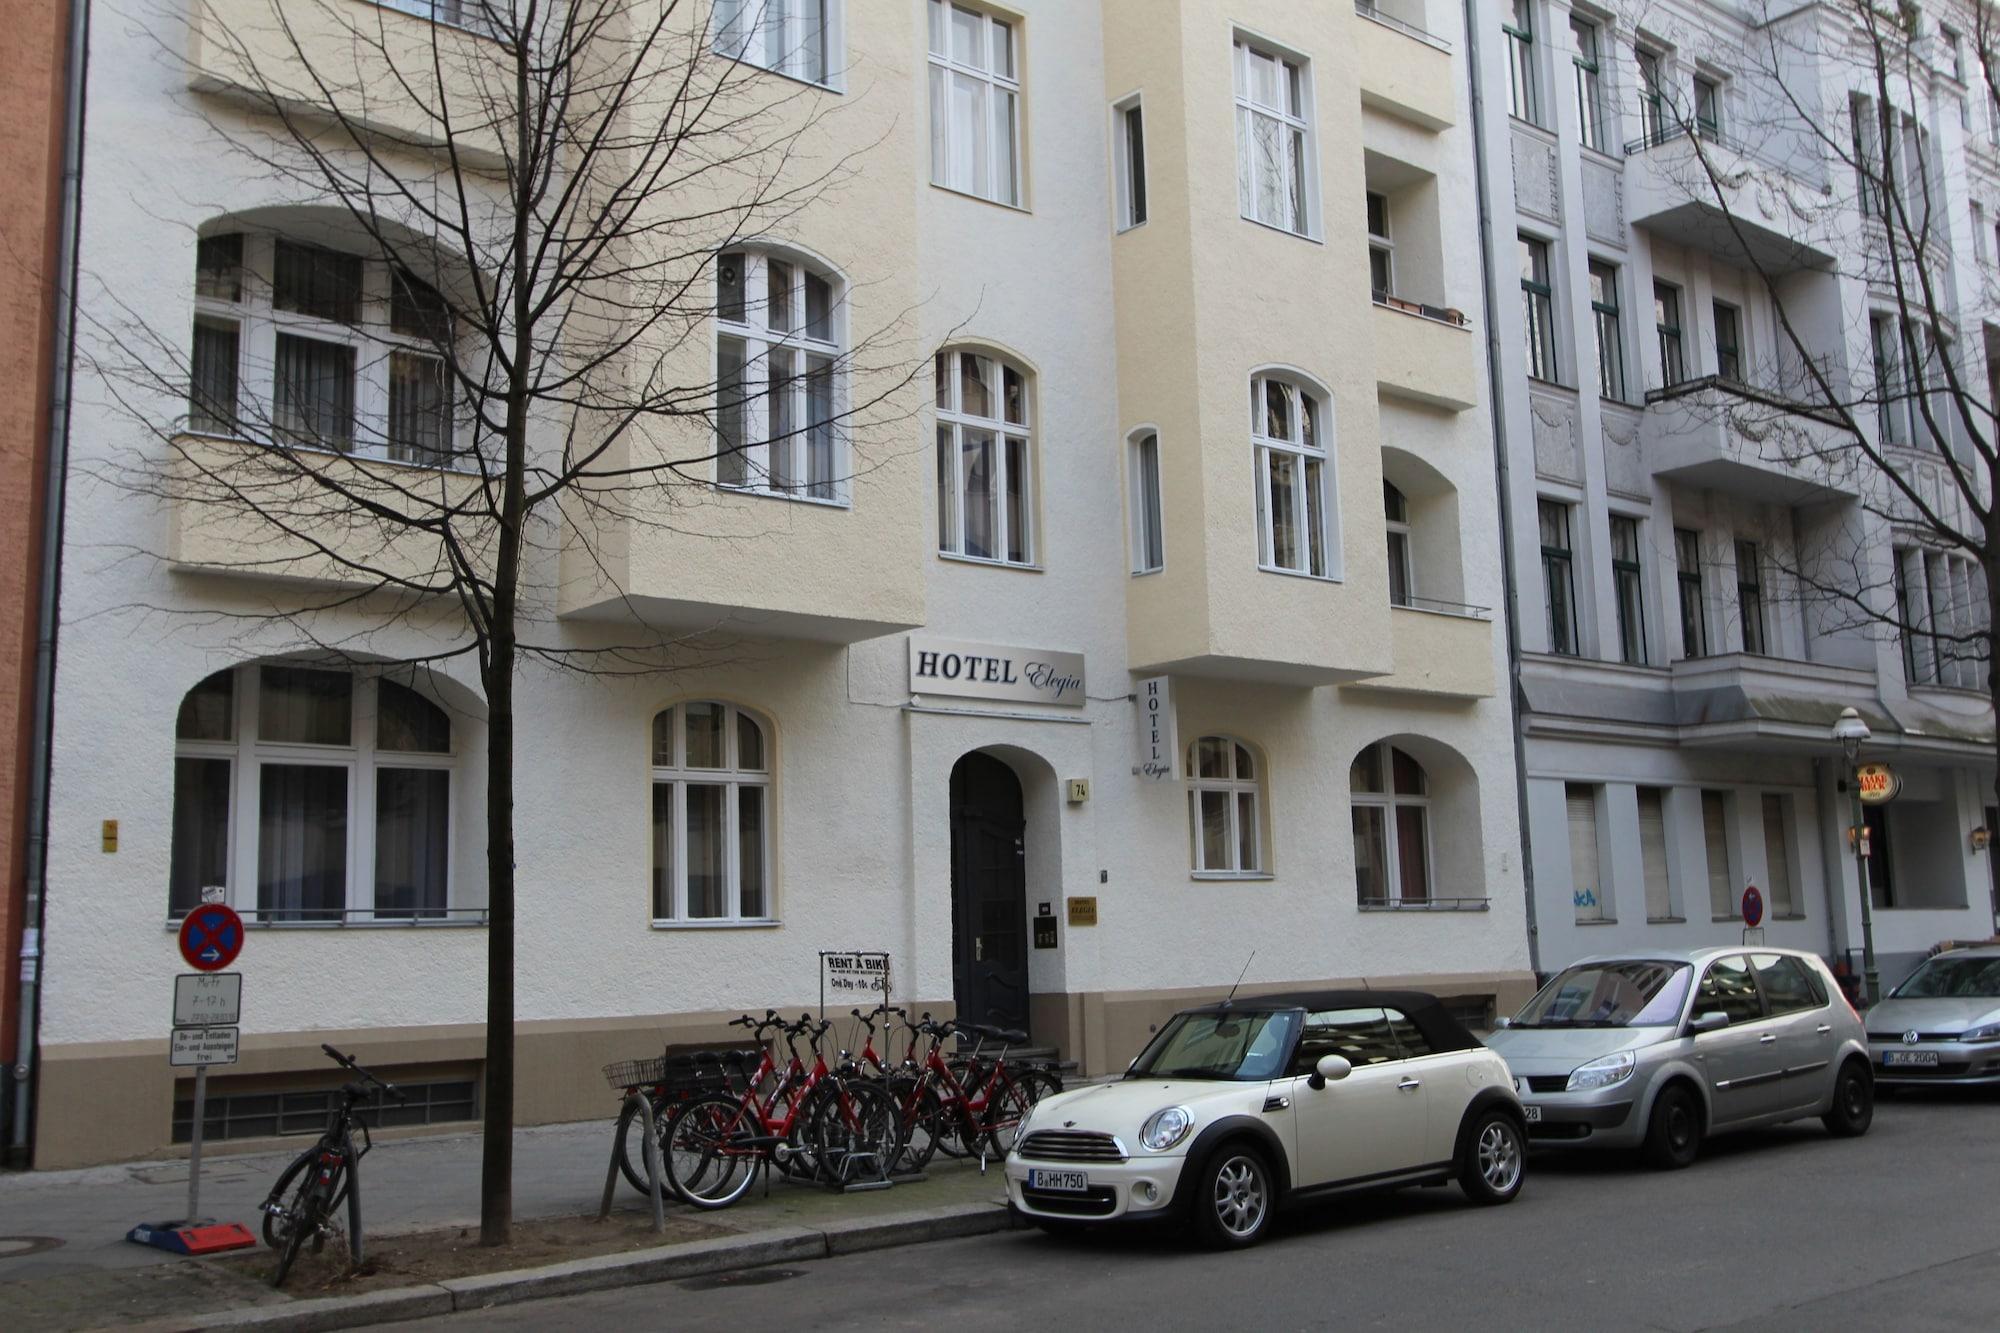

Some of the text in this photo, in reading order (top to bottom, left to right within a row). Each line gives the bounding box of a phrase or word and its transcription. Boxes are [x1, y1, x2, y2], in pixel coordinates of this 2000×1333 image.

[916, 651, 1081, 698] HOTEL Elegia
[1148, 681, 1160, 760] HOTEL
[1143, 763, 1170, 780] Elegia
[1076, 784, 1085, 796] 74
[828, 957, 853, 969] RENT
[856, 958, 863, 969] A
[831, 978, 842, 988] One
[843, 978, 853, 991] Day
[192, 1031, 203, 1041] und
[174, 1042, 234, 1052] Ein- und Aussteigen
[197, 1053, 212, 1061] frei
[1525, 1107, 1538, 1119] 28
[1037, 1171, 1044, 1187] B
